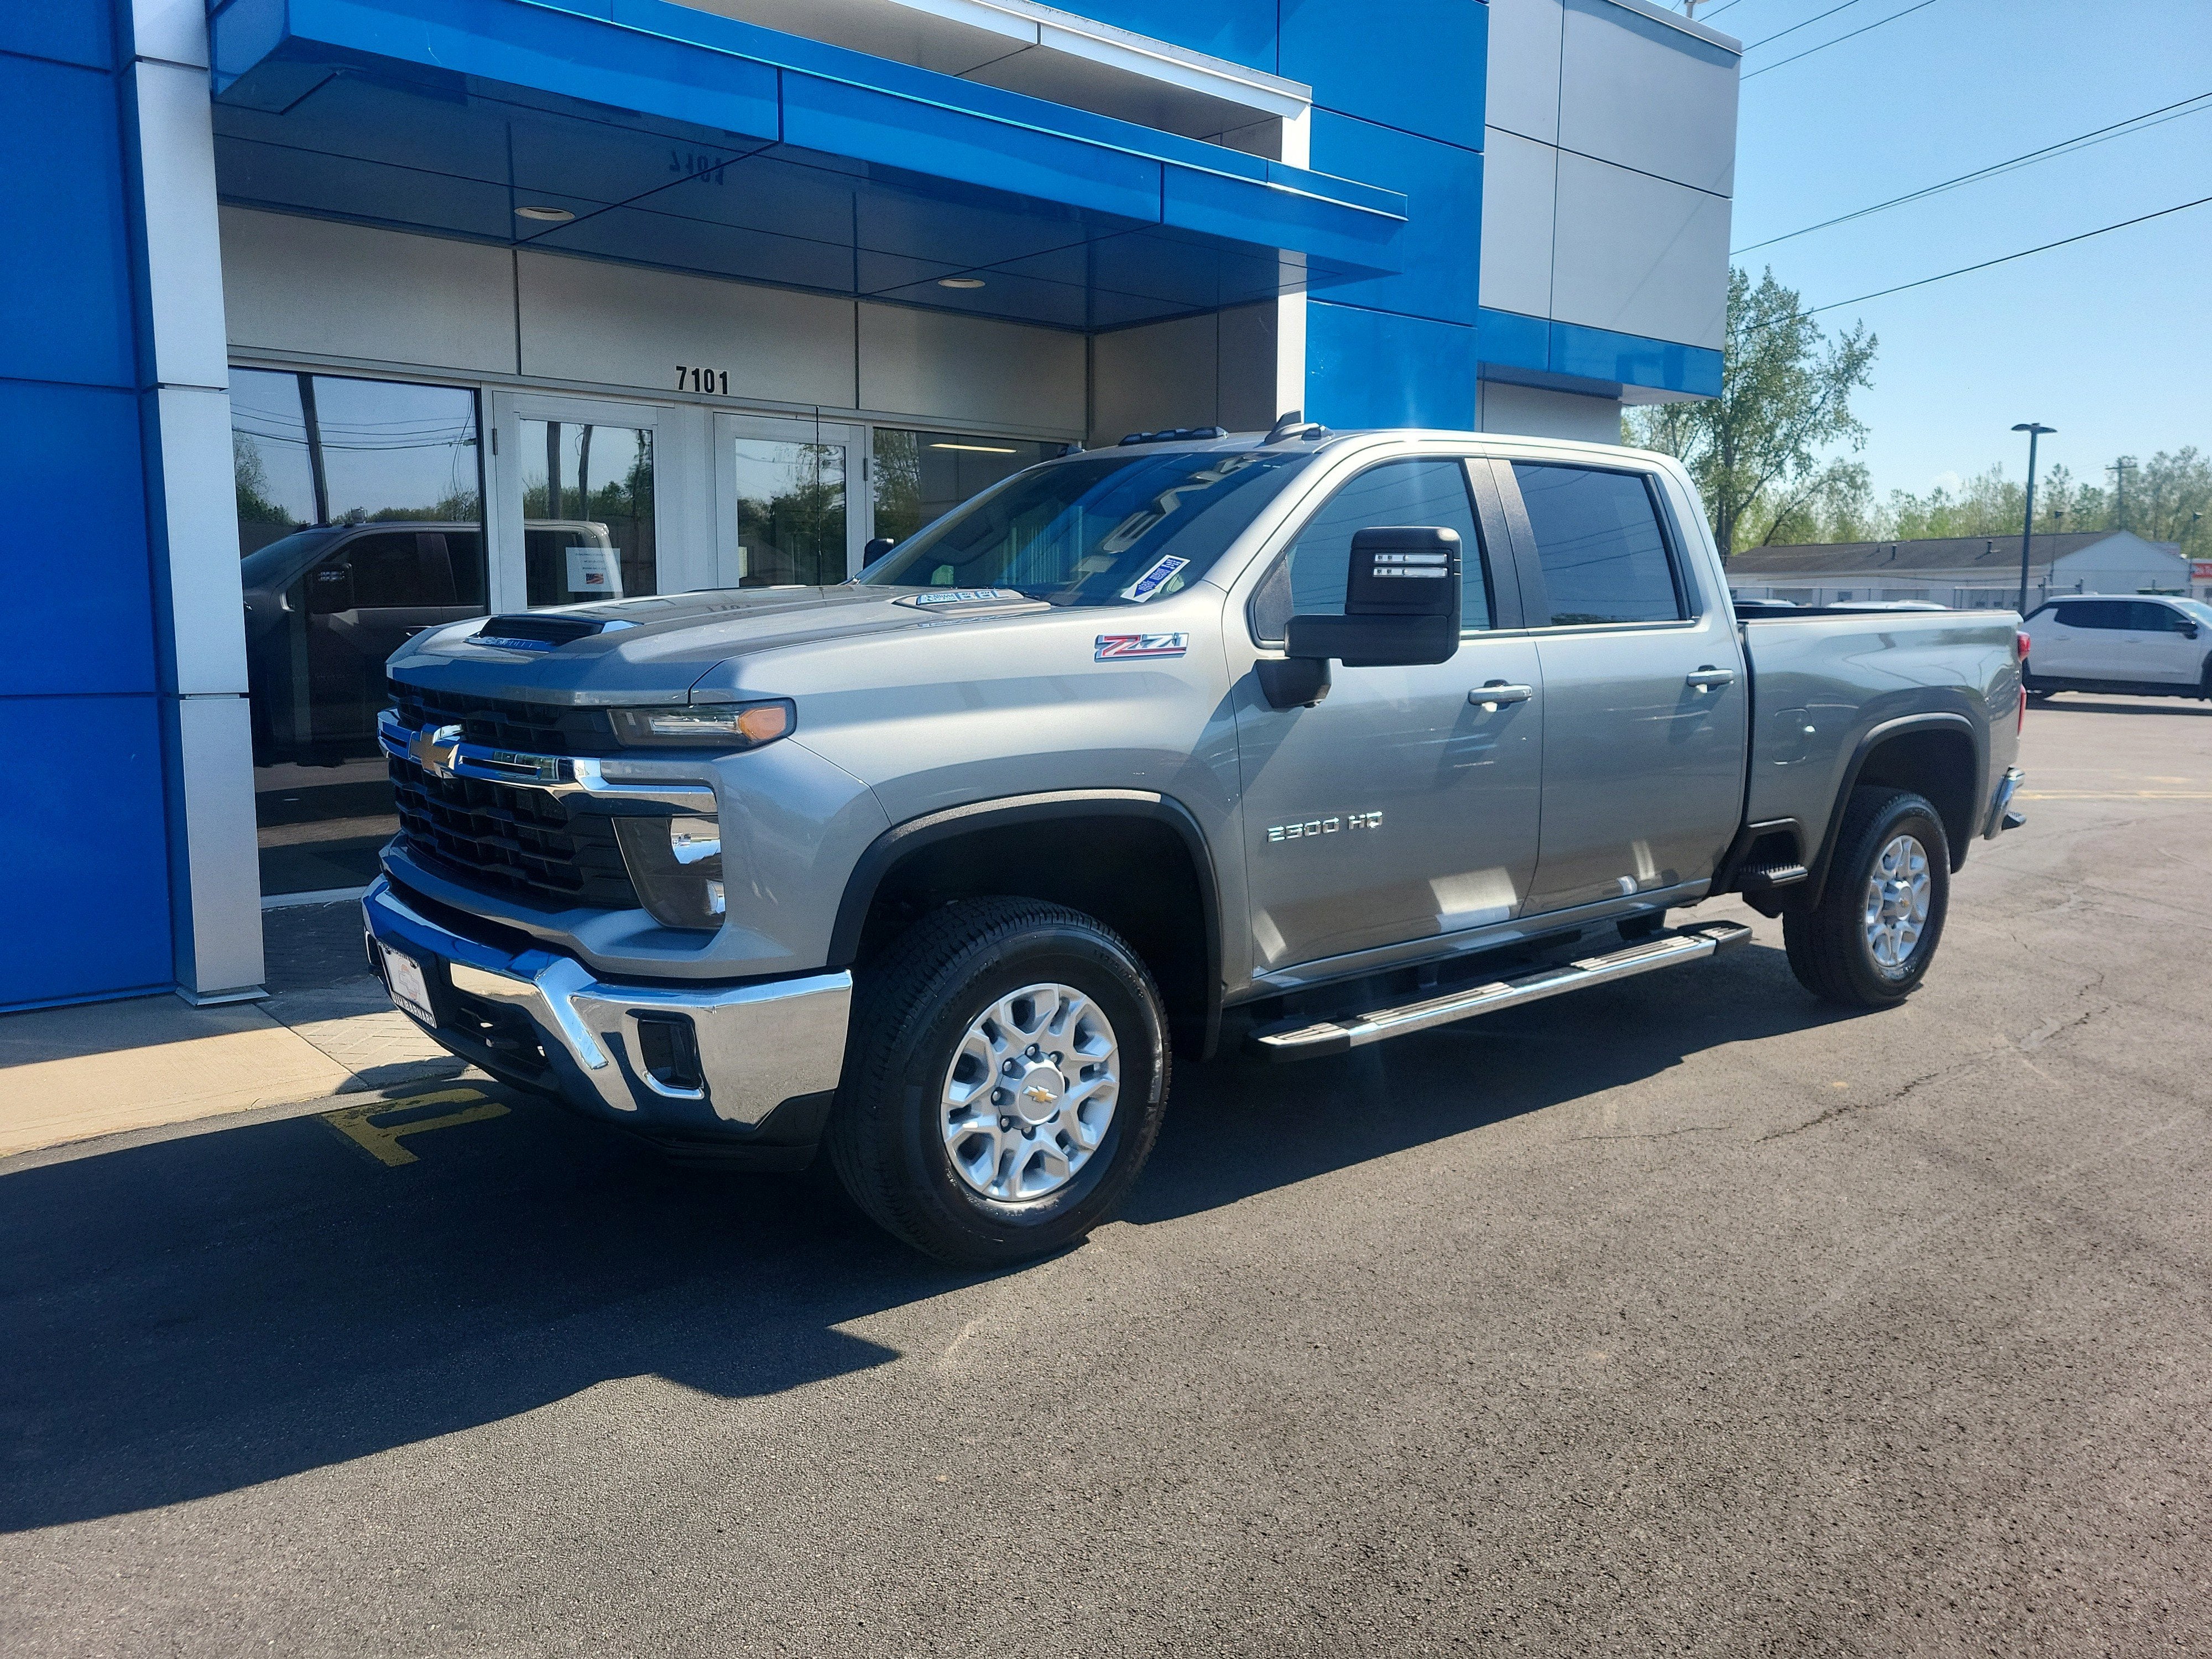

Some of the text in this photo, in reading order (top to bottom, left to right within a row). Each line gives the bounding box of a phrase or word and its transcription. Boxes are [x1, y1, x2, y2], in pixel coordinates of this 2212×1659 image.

[676, 366, 728, 394] 7101
[1094, 633, 1189, 663] Z71
[1267, 817, 1339, 842] 2500
